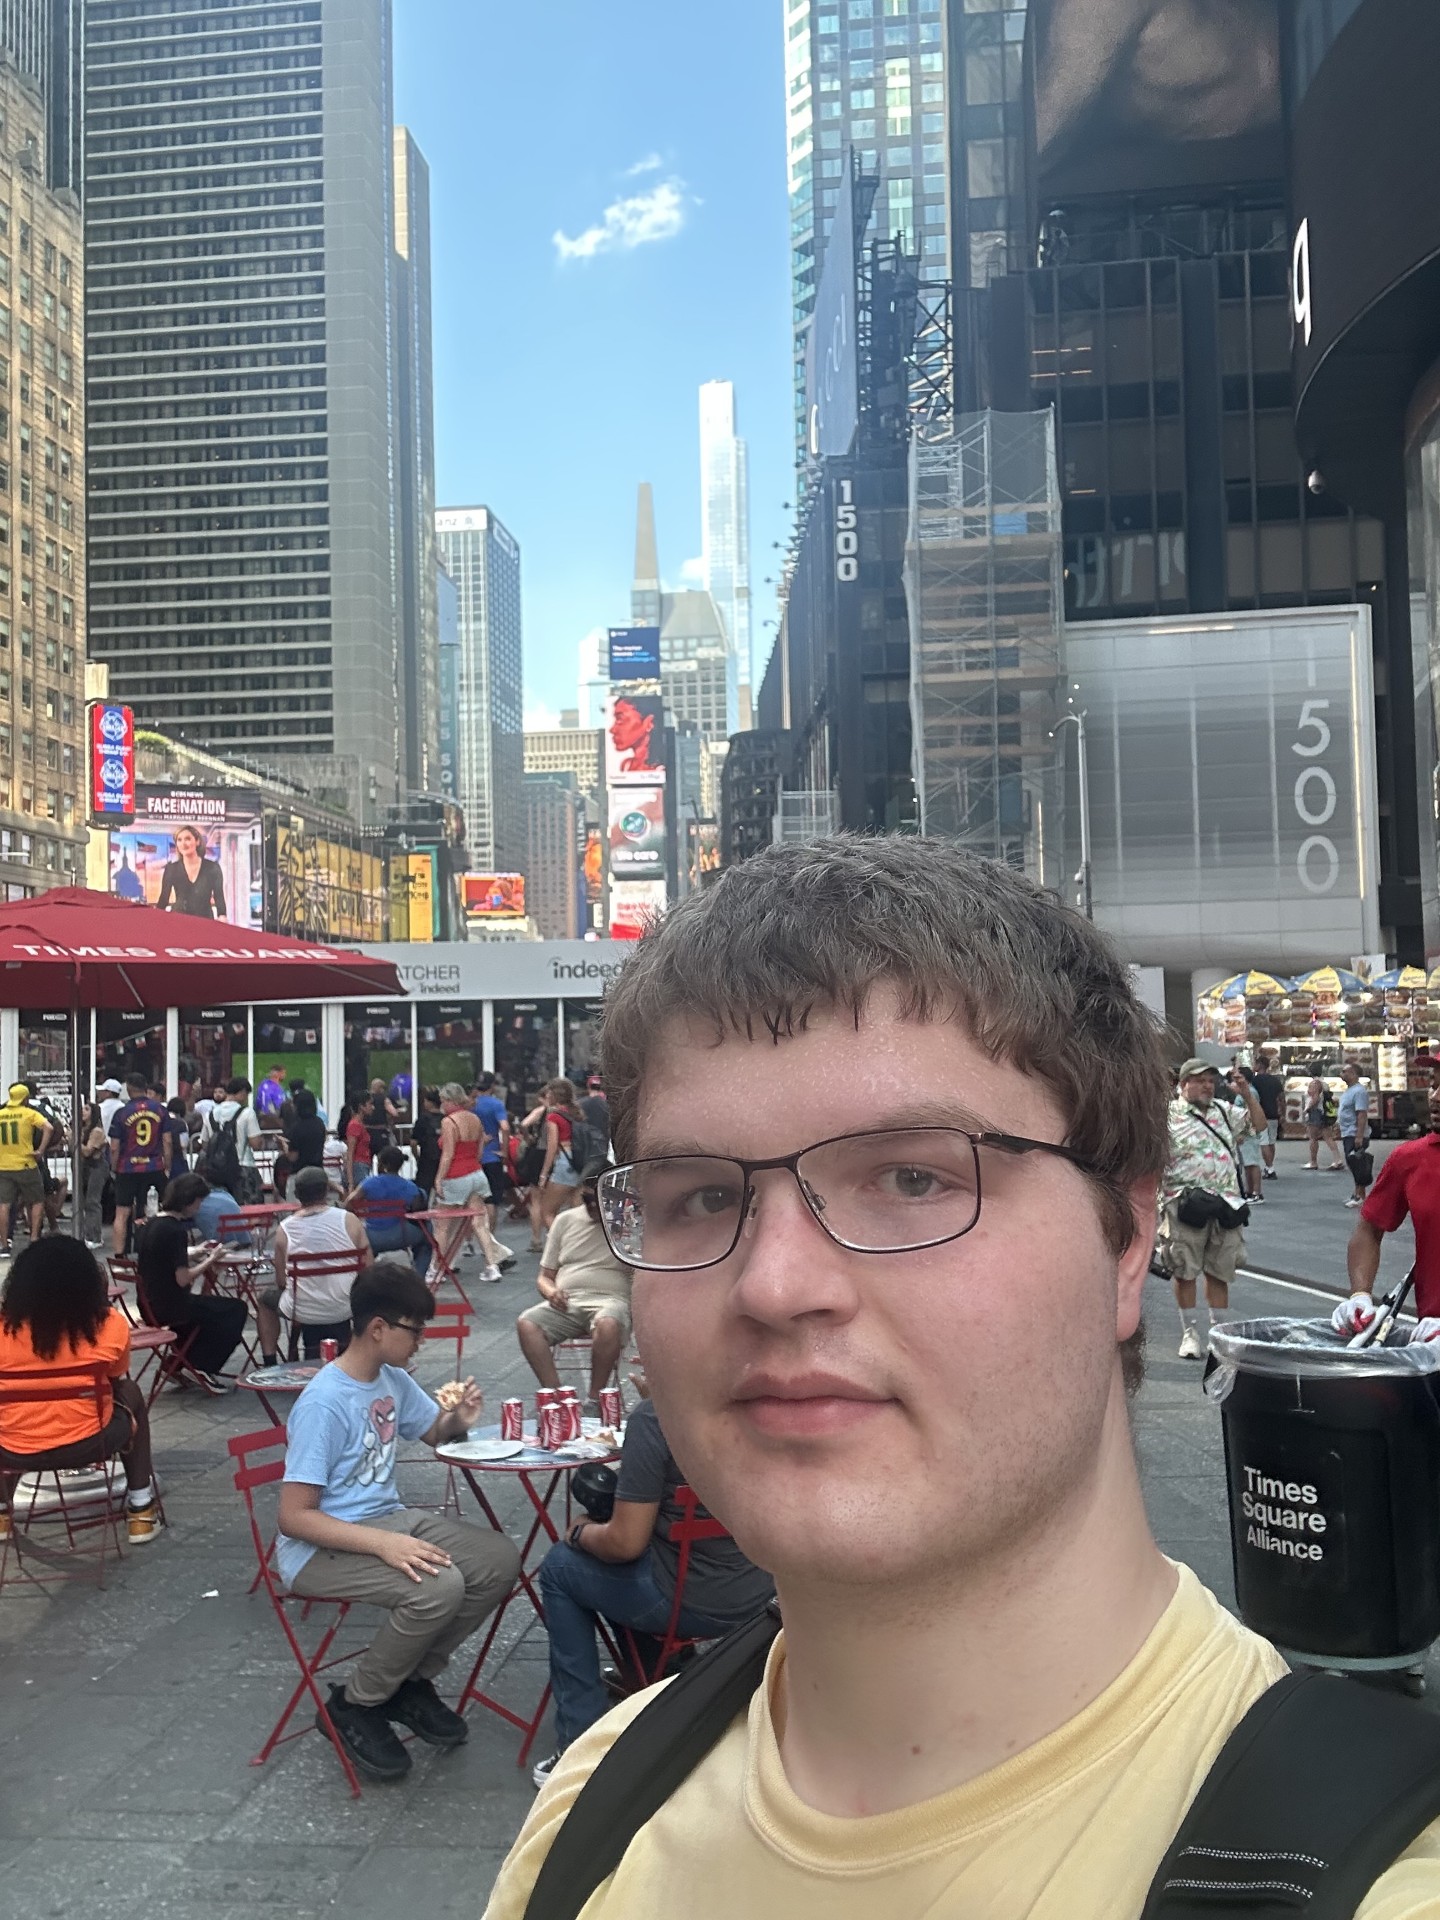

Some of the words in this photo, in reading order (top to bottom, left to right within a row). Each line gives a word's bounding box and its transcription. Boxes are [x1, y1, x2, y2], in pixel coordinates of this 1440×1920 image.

[836, 480, 858, 582] 1500
[1291, 632, 1340, 894] 1500
[147, 798, 177, 813] FACE
[180, 800, 226, 815] NATION
[13, 944, 156, 957] TIMES
[165, 947, 338, 960] SQUARE
[136, 1119, 151, 1146] 9
[1243, 1465, 1318, 1505] Times
[1242, 1491, 1327, 1533] Square
[1247, 1524, 1323, 1561] Alliance
